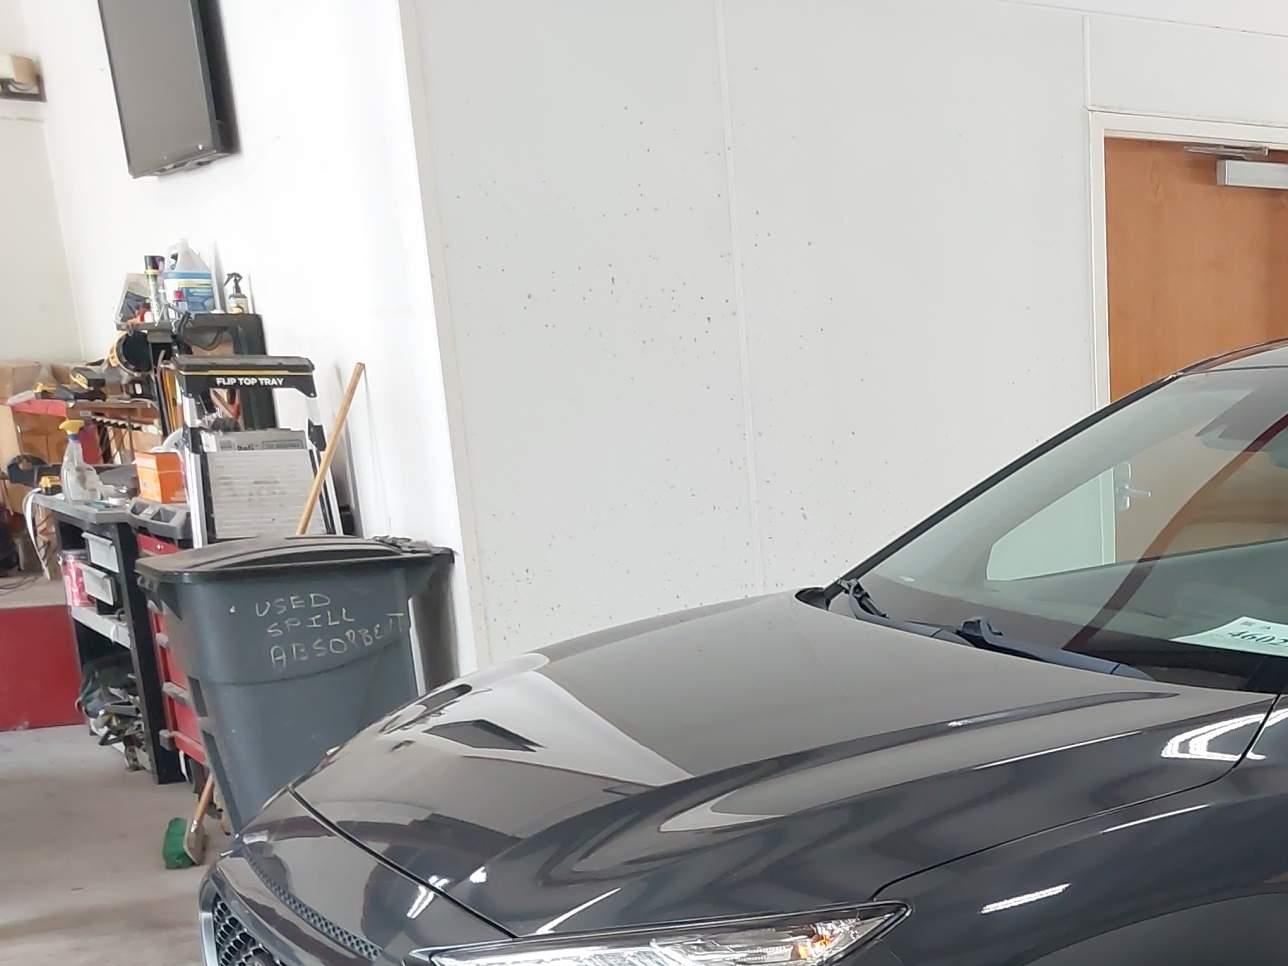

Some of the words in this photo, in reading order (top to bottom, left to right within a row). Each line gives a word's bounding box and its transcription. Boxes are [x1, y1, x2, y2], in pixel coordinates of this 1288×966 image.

[216, 378, 237, 386] FLIP
[238, 378, 258, 386] TOP
[258, 378, 284, 386] TRAY
[255, 592, 331, 617] USED
[267, 607, 355, 637] SPILL
